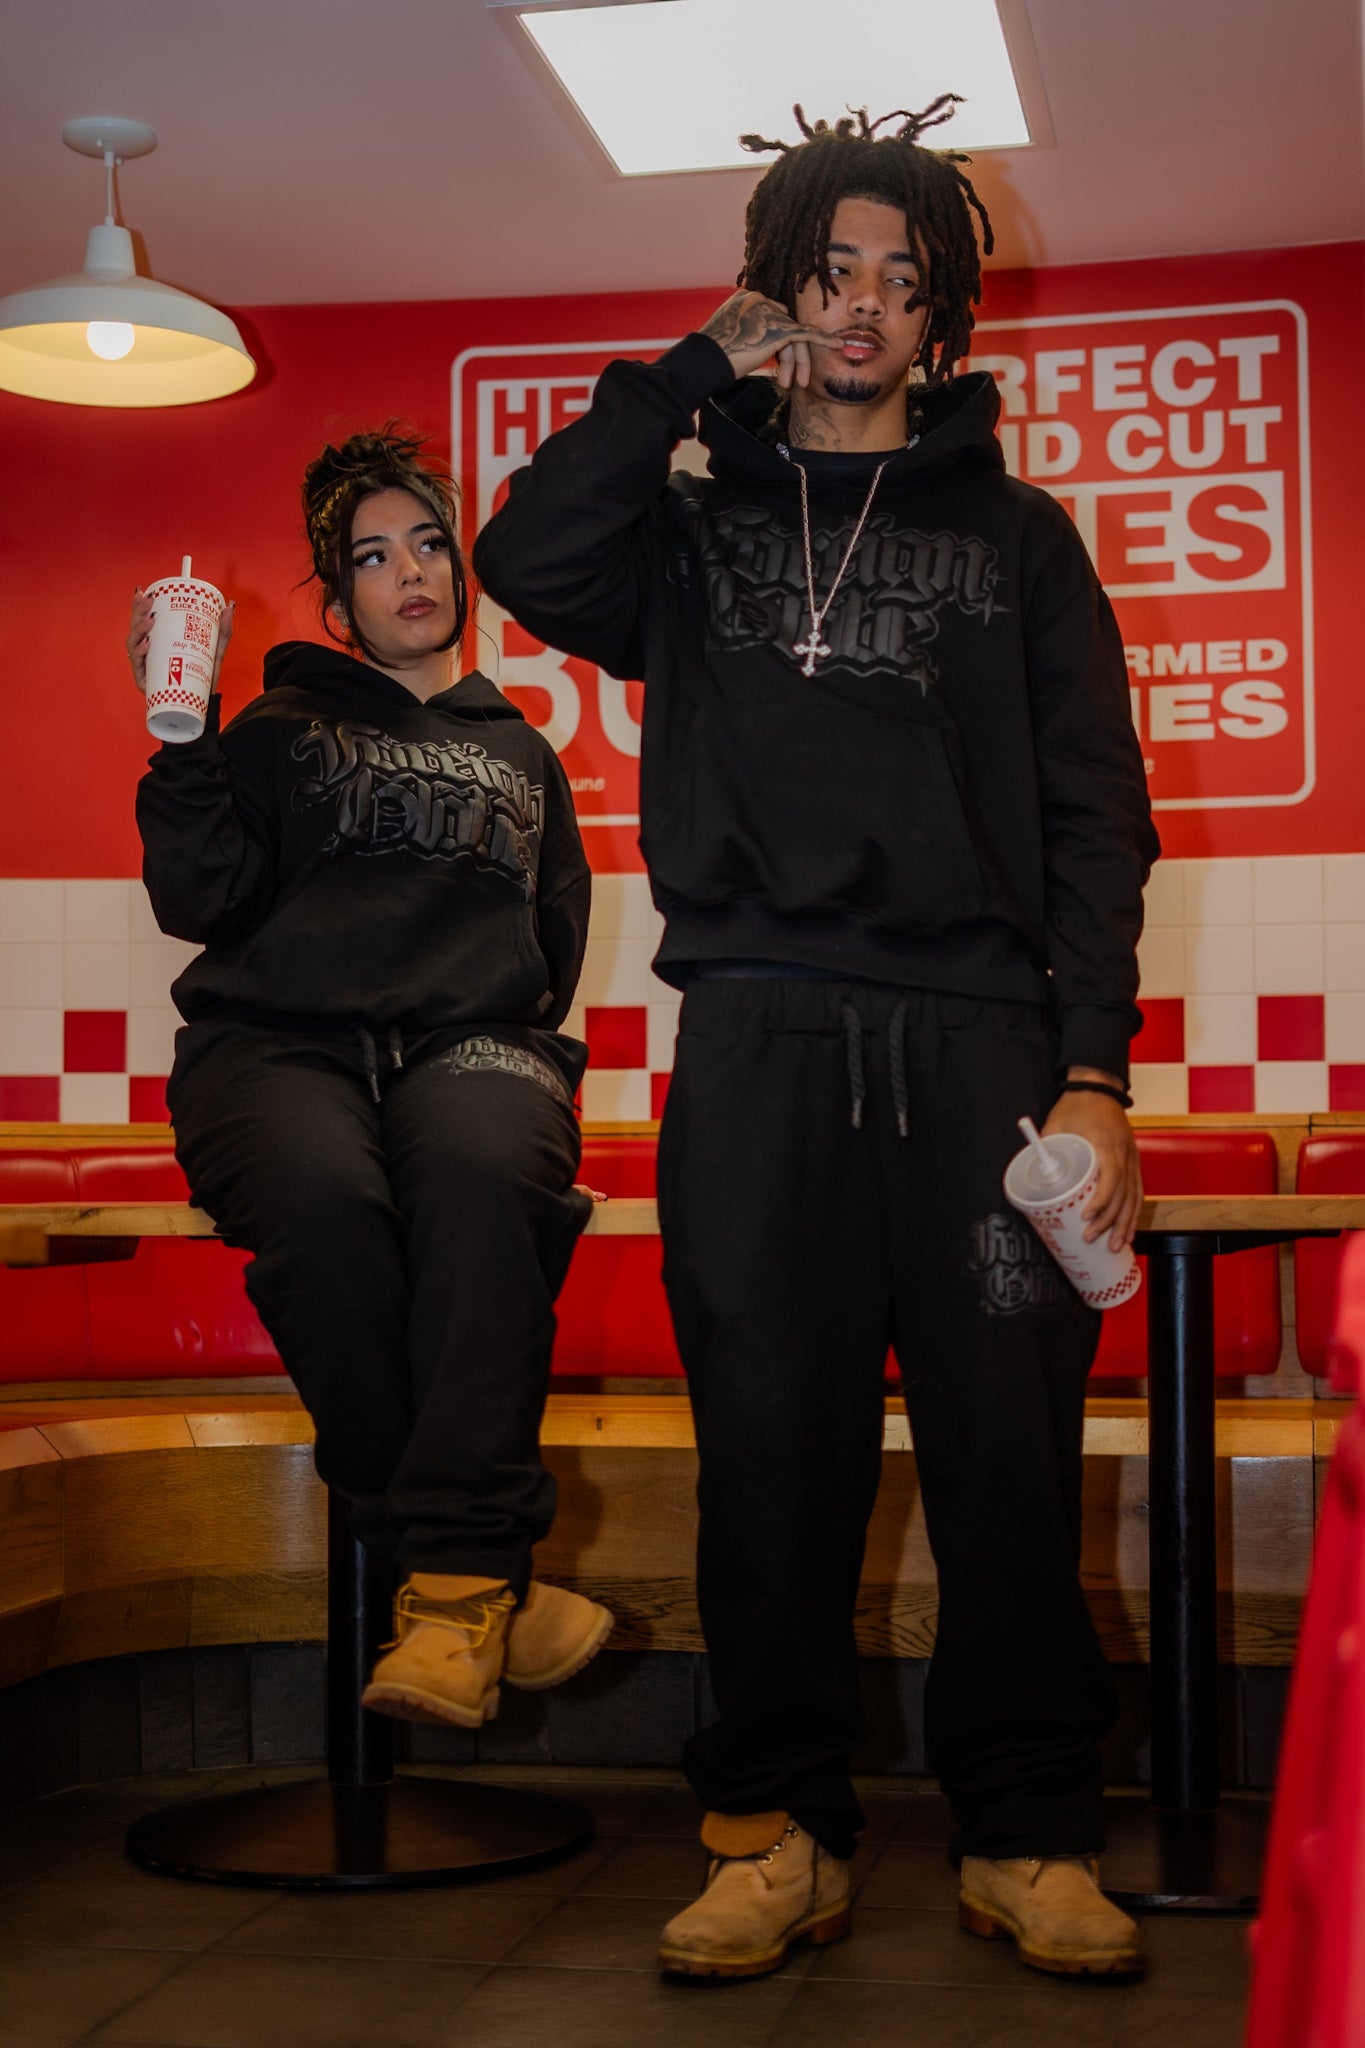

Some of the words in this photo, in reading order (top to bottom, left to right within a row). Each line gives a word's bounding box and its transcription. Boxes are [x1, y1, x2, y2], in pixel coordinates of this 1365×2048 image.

[964, 335, 1280, 416] RFECT
[1106, 405, 1282, 473] CUT
[170, 596, 198, 605] FIVE
[201, 602, 219, 617] GUY
[1124, 638, 1288, 677] RMED
